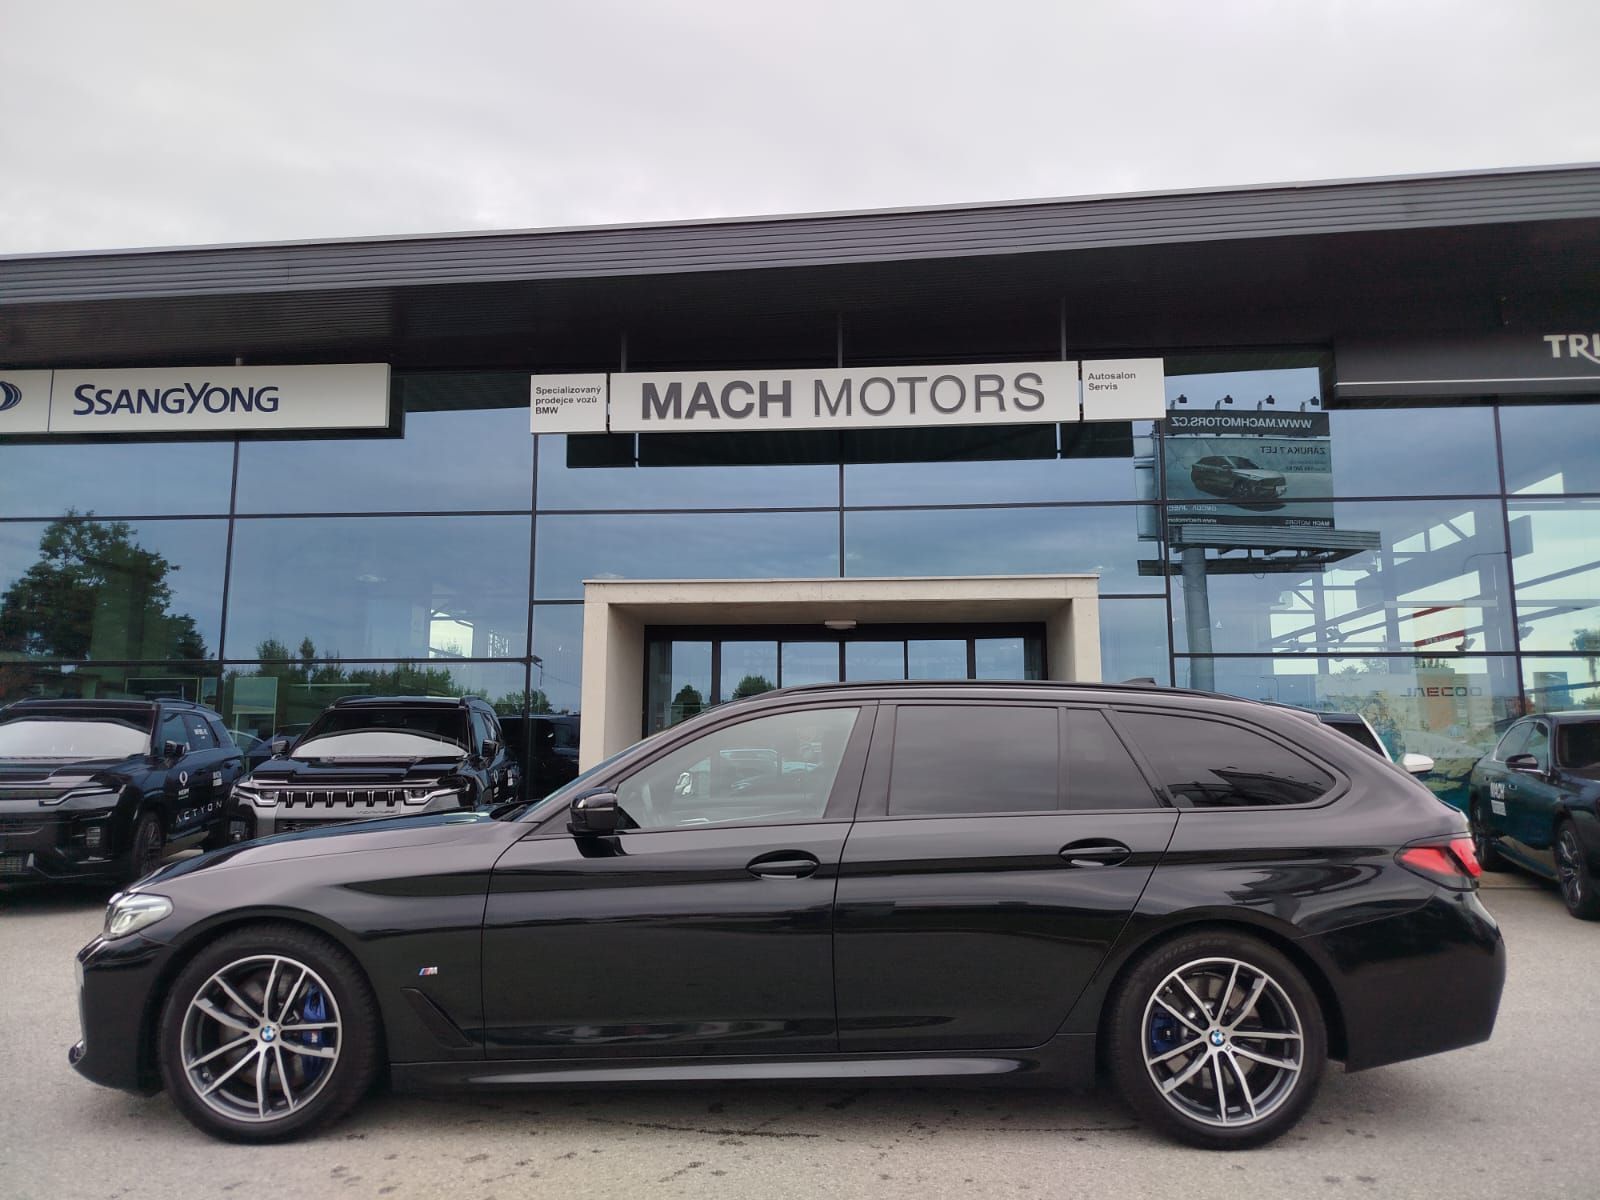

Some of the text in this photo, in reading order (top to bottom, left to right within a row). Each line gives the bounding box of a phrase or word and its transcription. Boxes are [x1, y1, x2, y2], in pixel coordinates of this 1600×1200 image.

[1088, 372, 1136, 380] Autosalon
[535, 385, 601, 395] Specializovaný
[1088, 383, 1118, 391] Servis
[535, 395, 598, 406] prodejce vozů
[641, 372, 1045, 420] MACH MOTORS
[535, 406, 559, 415] BMW
[1400, 686, 1482, 697] JAECOO
[176, 800, 222, 823] ACTYON
